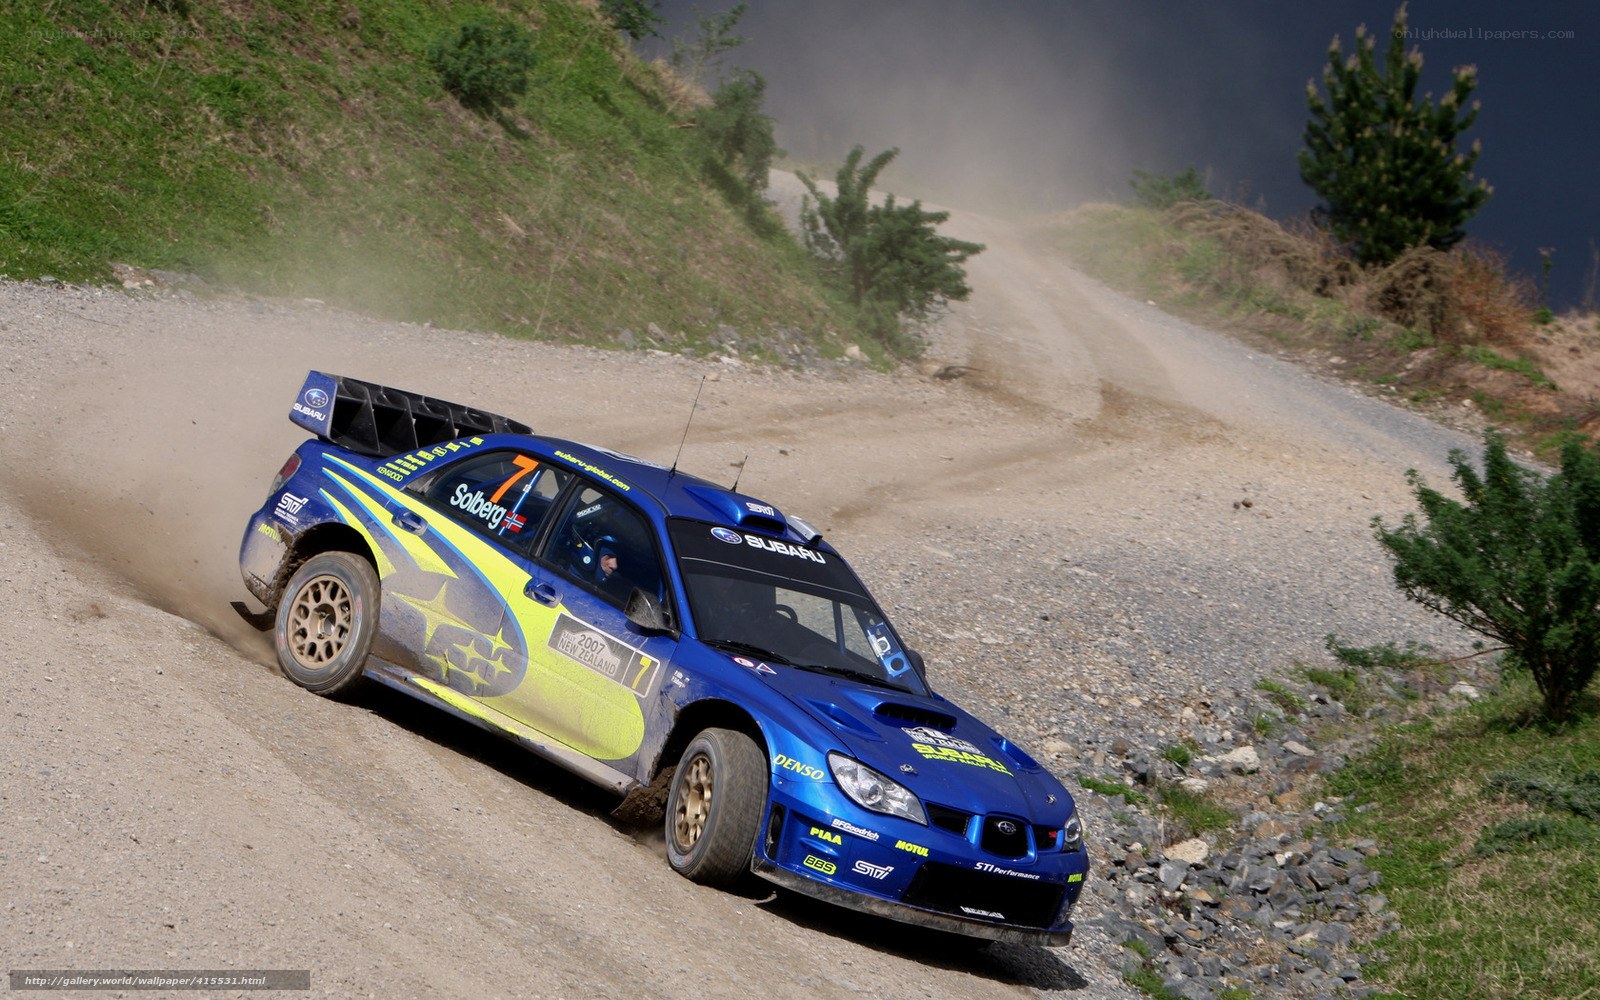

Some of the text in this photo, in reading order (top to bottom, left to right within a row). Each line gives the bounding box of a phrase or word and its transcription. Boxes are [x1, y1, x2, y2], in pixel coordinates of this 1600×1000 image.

[293, 402, 326, 421] SUBARU
[490, 454, 539, 503] 7
[554, 450, 630, 492] subaru-global.com
[450, 483, 507, 530] Solberg
[744, 534, 826, 564] SUBARU
[559, 637, 616, 676] NEW ZEALAND
[577, 634, 605, 655] 2007
[631, 656, 652, 689] 7
[773, 753, 825, 781] DENSO
[912, 743, 1007, 771] SUBARU
[810, 827, 842, 845] PIAA
[831, 818, 880, 840] BFGoodrich
[895, 840, 929, 857] MOTUL
[804, 856, 835, 873] BBS
[974, 862, 1040, 880] STI Performance
